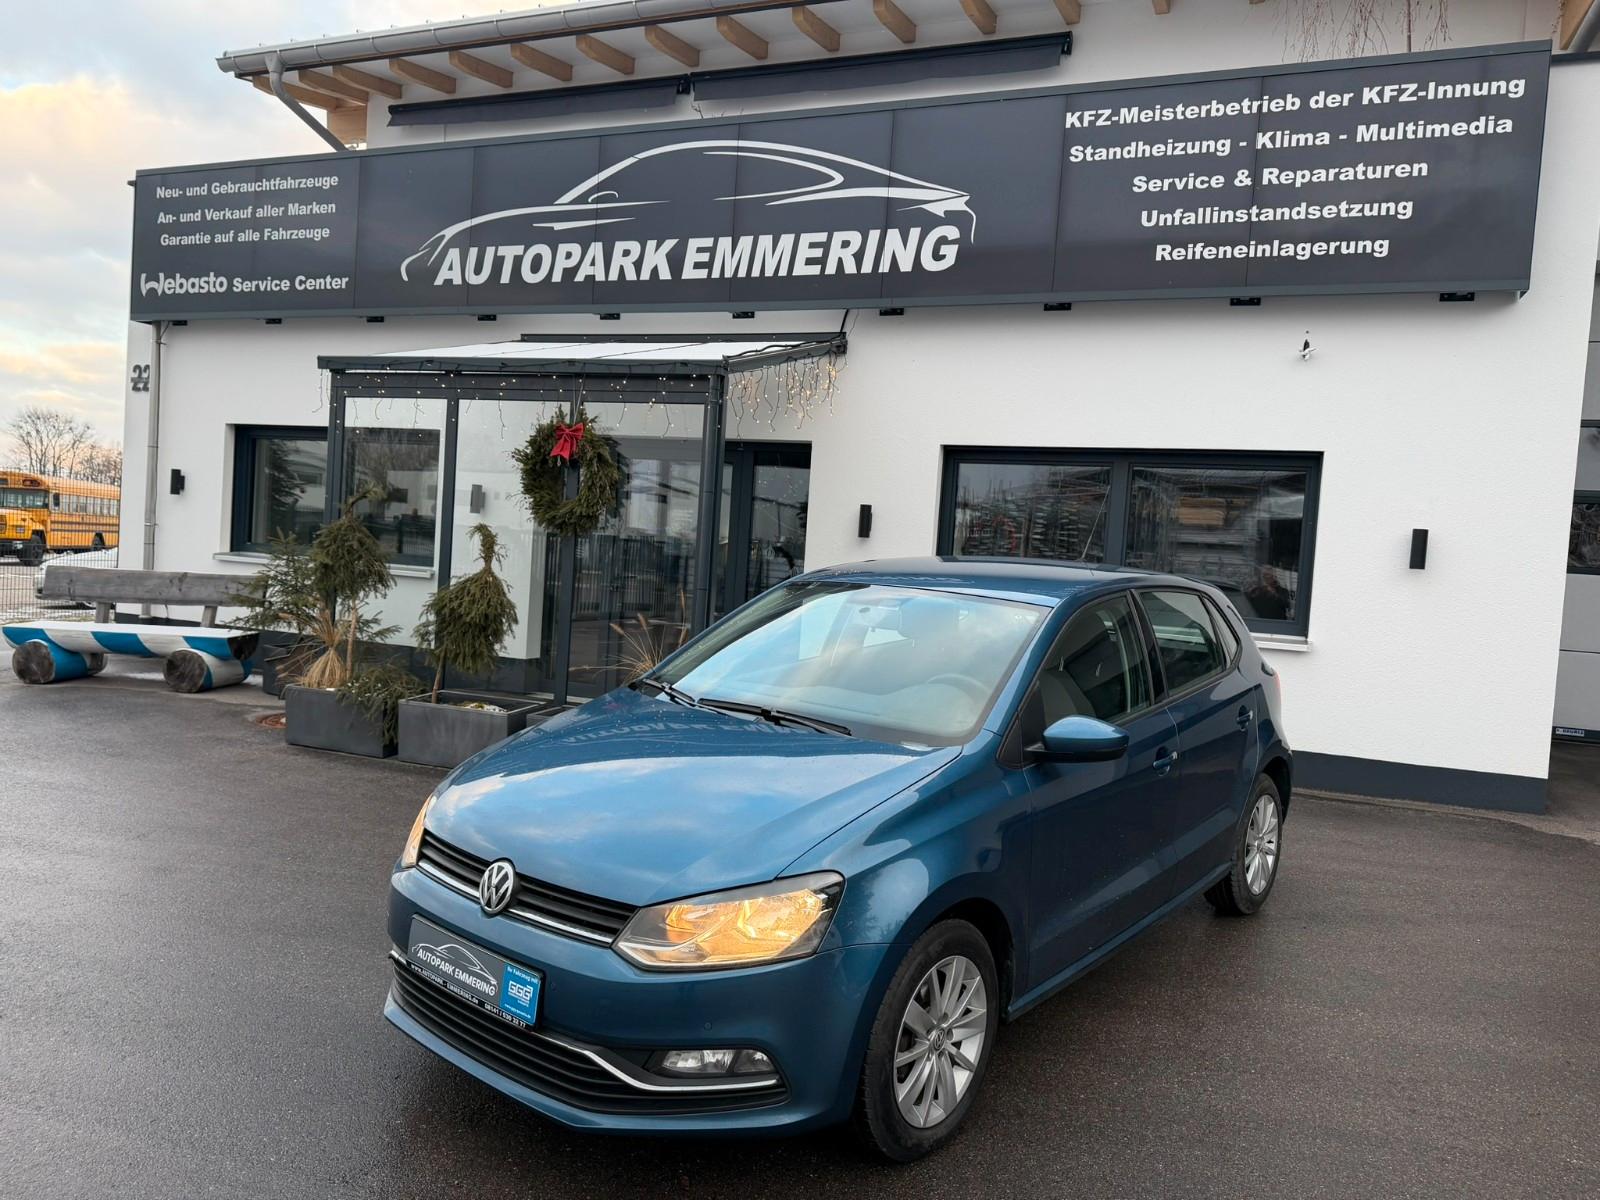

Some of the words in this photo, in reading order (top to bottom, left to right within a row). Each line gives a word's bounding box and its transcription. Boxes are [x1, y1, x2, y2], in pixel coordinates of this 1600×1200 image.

[1065, 93, 1300, 129] KFZ-Meisterbetrieb
[1309, 89, 1354, 110] der
[1361, 78, 1526, 106] KFZ-Innung
[1069, 137, 1231, 163] Standheizung
[1256, 130, 1330, 150] Klima
[1356, 116, 1513, 144] Multimedia
[156, 186, 183, 199] Neu-
[186, 185, 207, 197] und
[211, 175, 339, 195] Gebrauchtfahrzeuge
[1132, 172, 1225, 193] Service
[1234, 169, 1252, 187] &
[1262, 160, 1429, 188] Reparaturen
[157, 211, 177, 224] An-
[180, 210, 201, 223] und
[204, 206, 253, 221] Verkauf
[256, 204, 284, 218] aller
[287, 203, 336, 216] Marken
[1140, 198, 1413, 228] Unfallinstandsetzung
[160, 232, 211, 246] Garantie
[214, 230, 234, 243] auf
[237, 229, 260, 242] alle
[264, 227, 330, 241] Fahrzeuge
[1155, 237, 1390, 262] Reifeneinlagerung
[433, 239, 678, 286] AUTOPARK
[681, 225, 961, 280] EMMERING
[140, 272, 228, 297] Webasto
[232, 276, 290, 292] Service
[294, 275, 349, 291] Center
[417, 948, 454, 977] AUTOPARK
[454, 969, 496, 997] EMMERING
